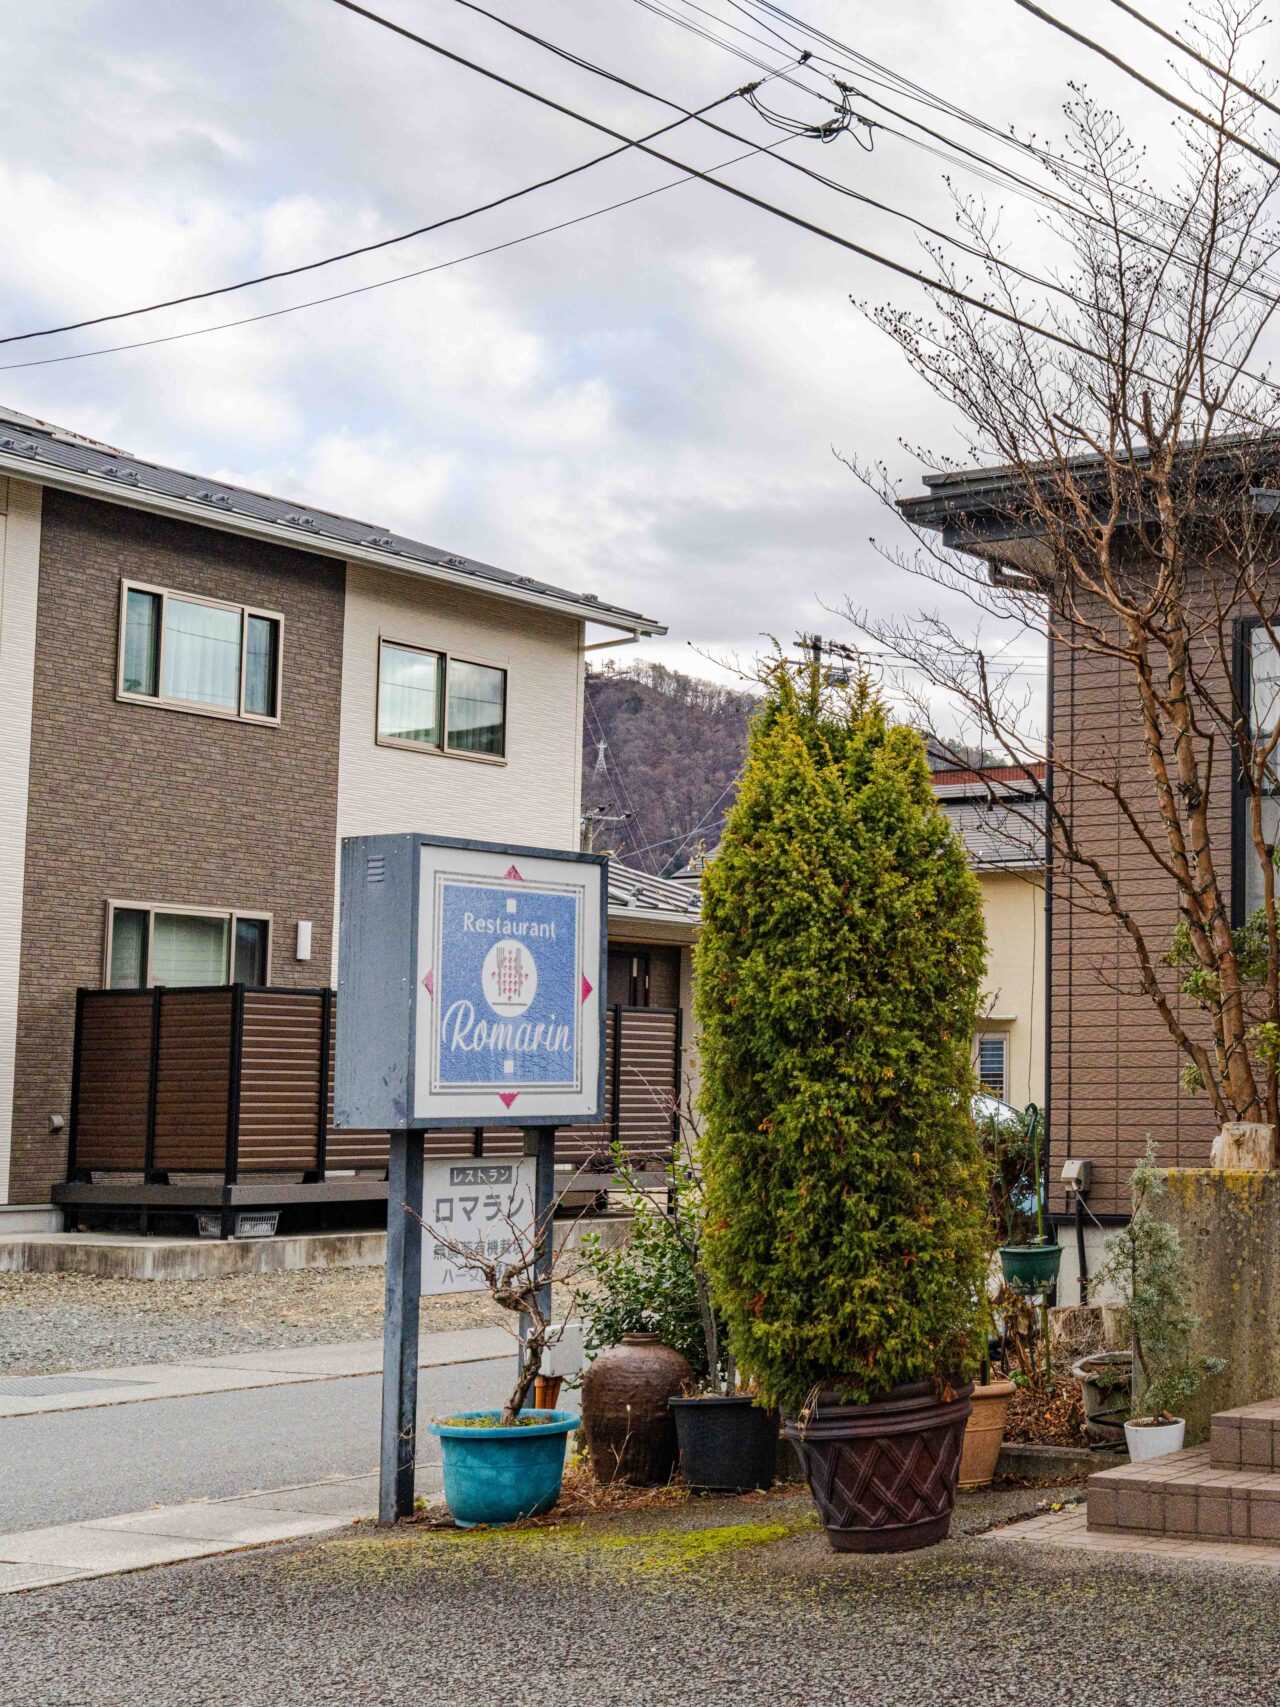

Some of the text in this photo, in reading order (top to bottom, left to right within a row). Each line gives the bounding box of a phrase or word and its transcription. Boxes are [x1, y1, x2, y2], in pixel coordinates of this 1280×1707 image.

[463, 911, 557, 938] Restaurant
[442, 1000, 572, 1051] Romarin
[453, 1168, 510, 1184] レストラン
[435, 1194, 525, 1223] ロマラン
